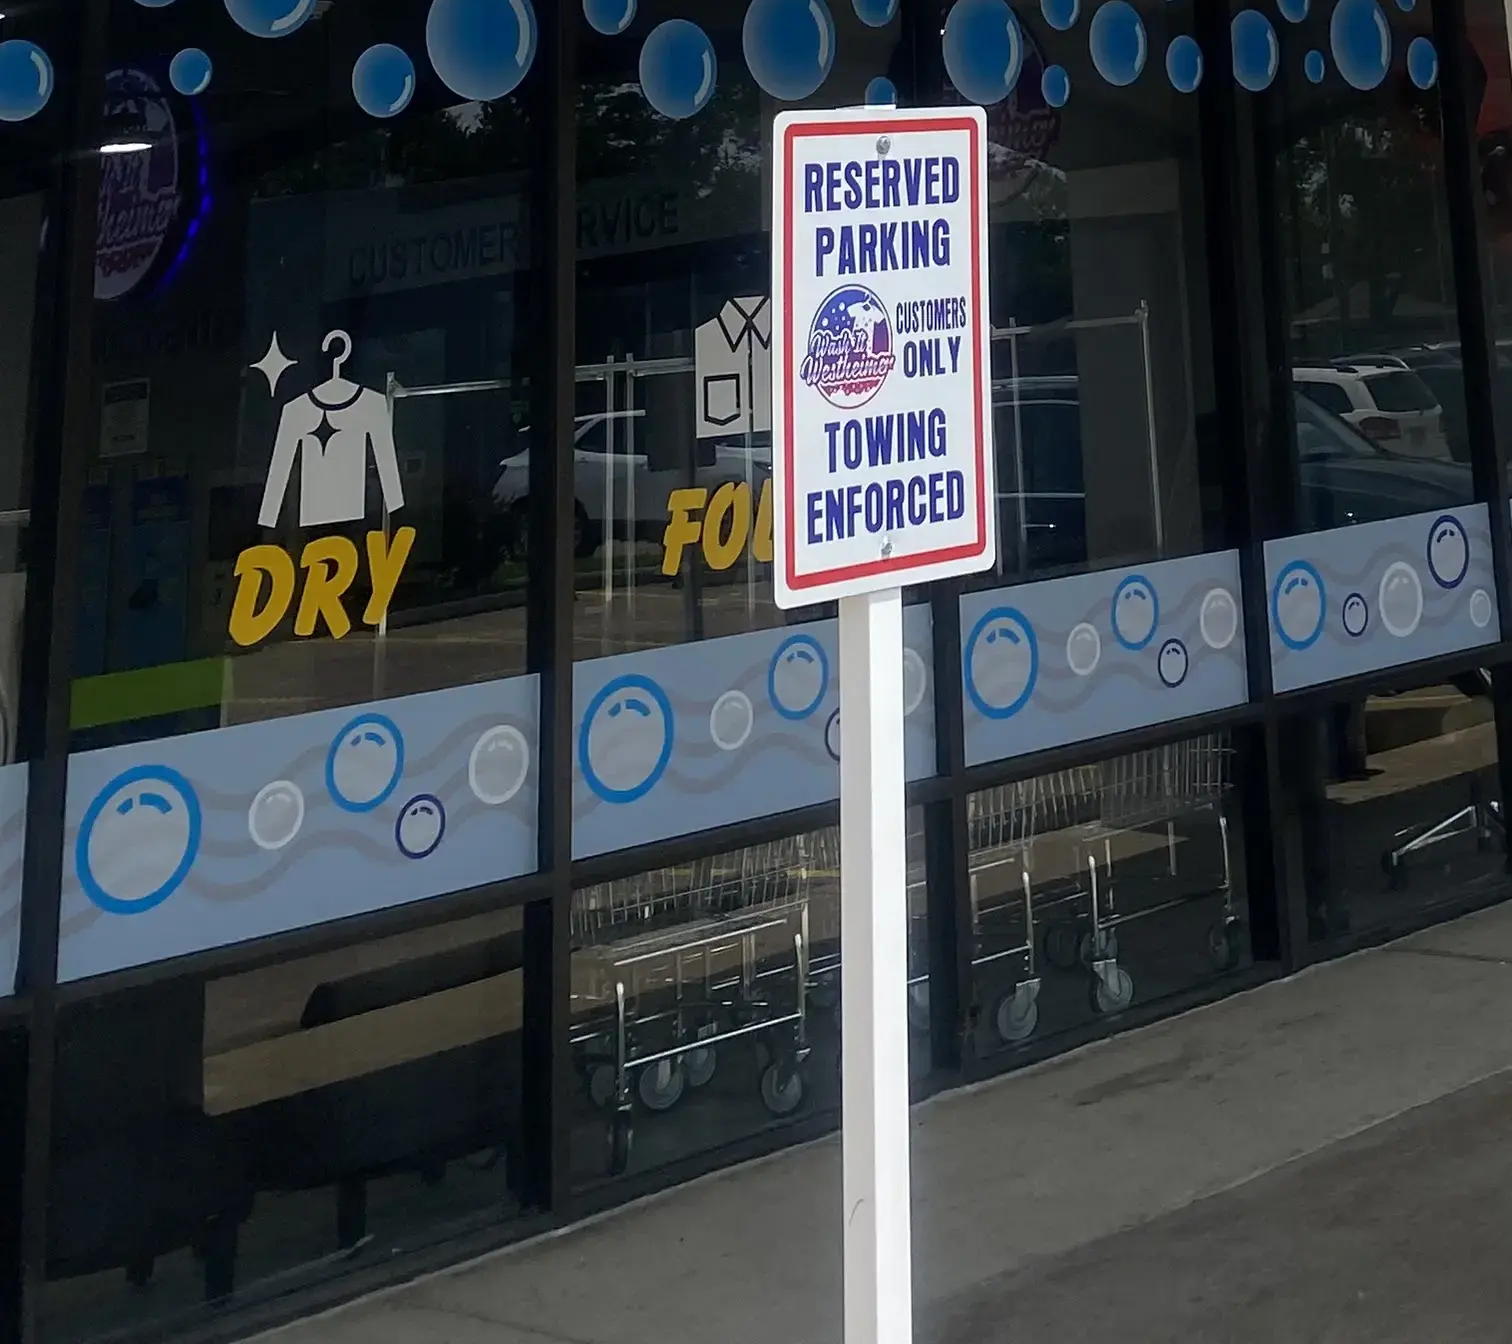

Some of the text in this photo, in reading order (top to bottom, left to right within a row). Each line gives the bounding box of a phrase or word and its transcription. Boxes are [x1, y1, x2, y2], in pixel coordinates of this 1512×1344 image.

[803, 156, 960, 213] RESERVED
[348, 193, 679, 286] CUSTOMER RVICE
[815, 218, 951, 277] PARKING
[811, 330, 867, 357] Wash It
[896, 296, 967, 334] CUSTOMERS
[800, 354, 896, 384] Westheimer
[903, 337, 962, 379] ONLY
[824, 407, 948, 474] TOWING
[661, 477, 774, 577] FOL
[806, 470, 965, 545] ENFORCED
[229, 526, 416, 647] DRY
